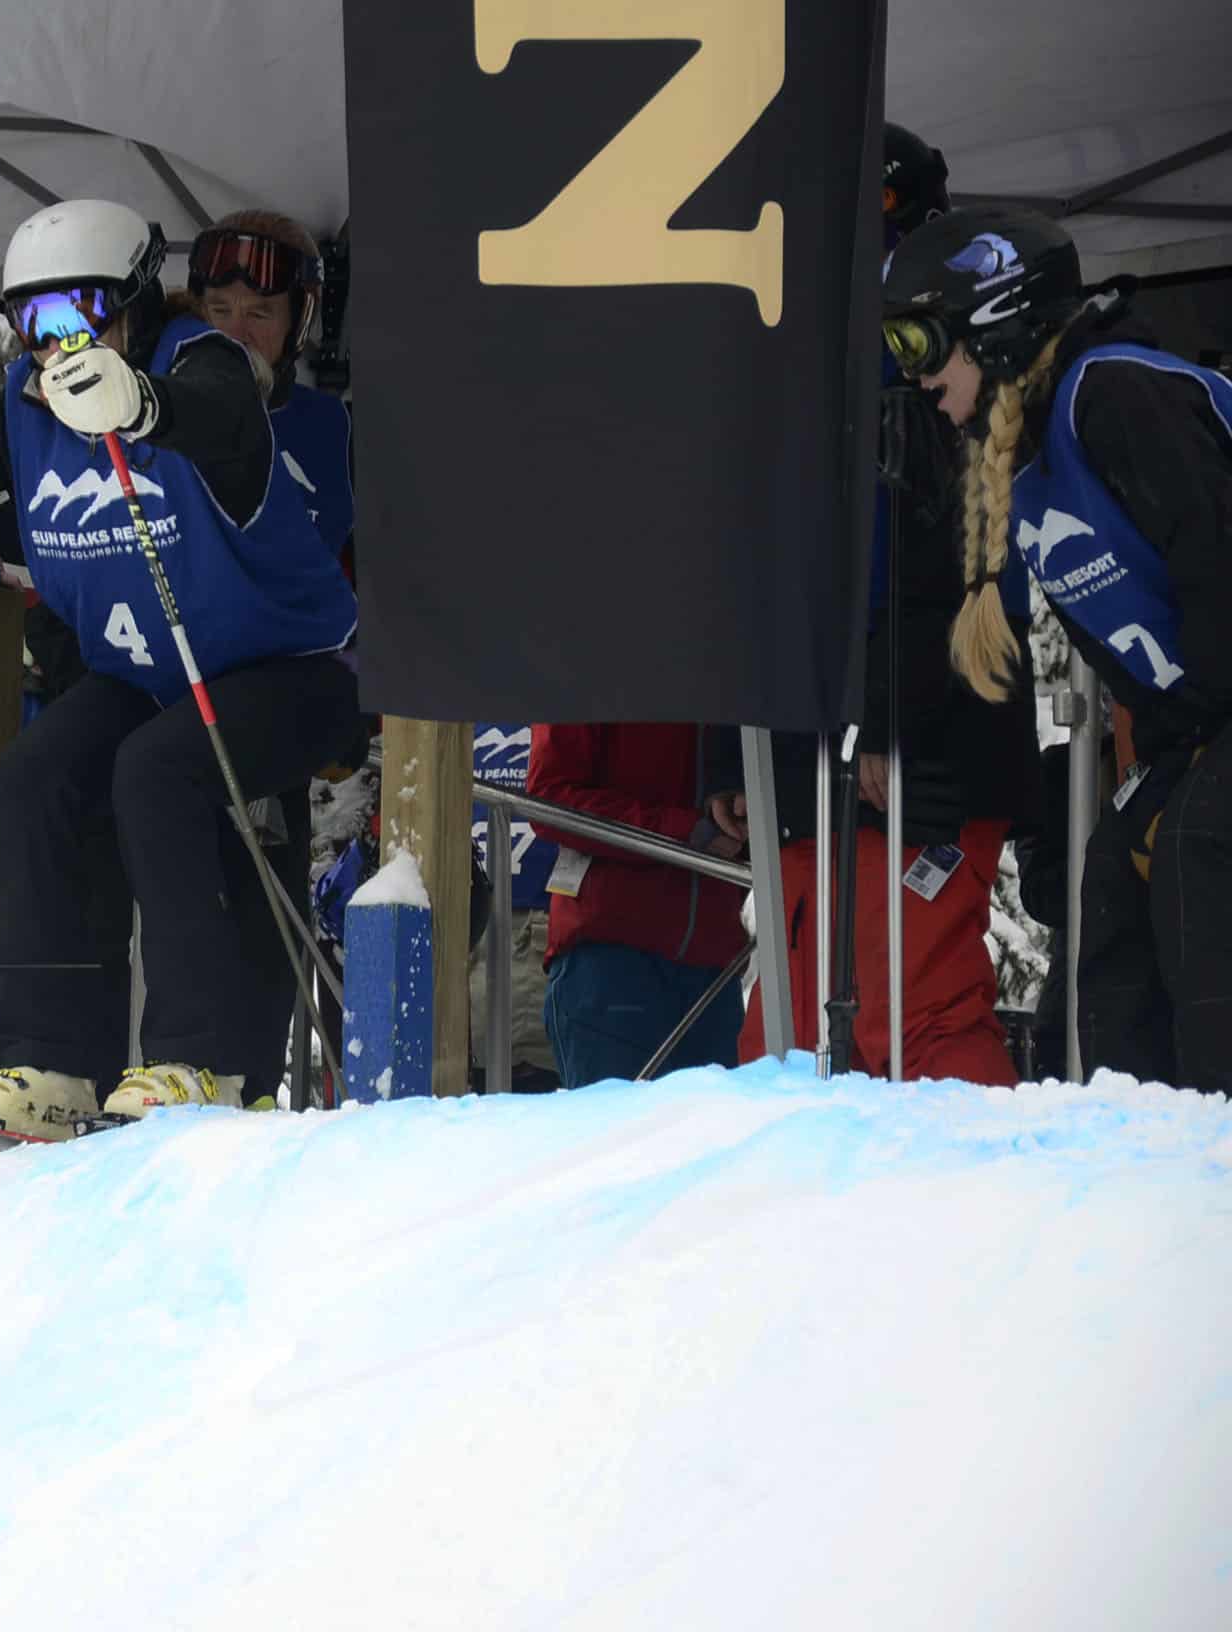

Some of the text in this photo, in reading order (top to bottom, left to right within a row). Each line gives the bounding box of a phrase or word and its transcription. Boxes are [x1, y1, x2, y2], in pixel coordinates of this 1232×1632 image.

[31, 530, 60, 547] SUN
[59, 529, 110, 548] PEAKS
[36, 532, 182, 560] BRITISH COLUMBIA CNADA
[128, 504, 157, 558] LEKI
[1064, 551, 1118, 589] RESORT
[1090, 567, 1129, 593] CANADA
[104, 602, 155, 667] 4
[1107, 623, 1185, 690] 7
[484, 767, 529, 780] PEAKS
